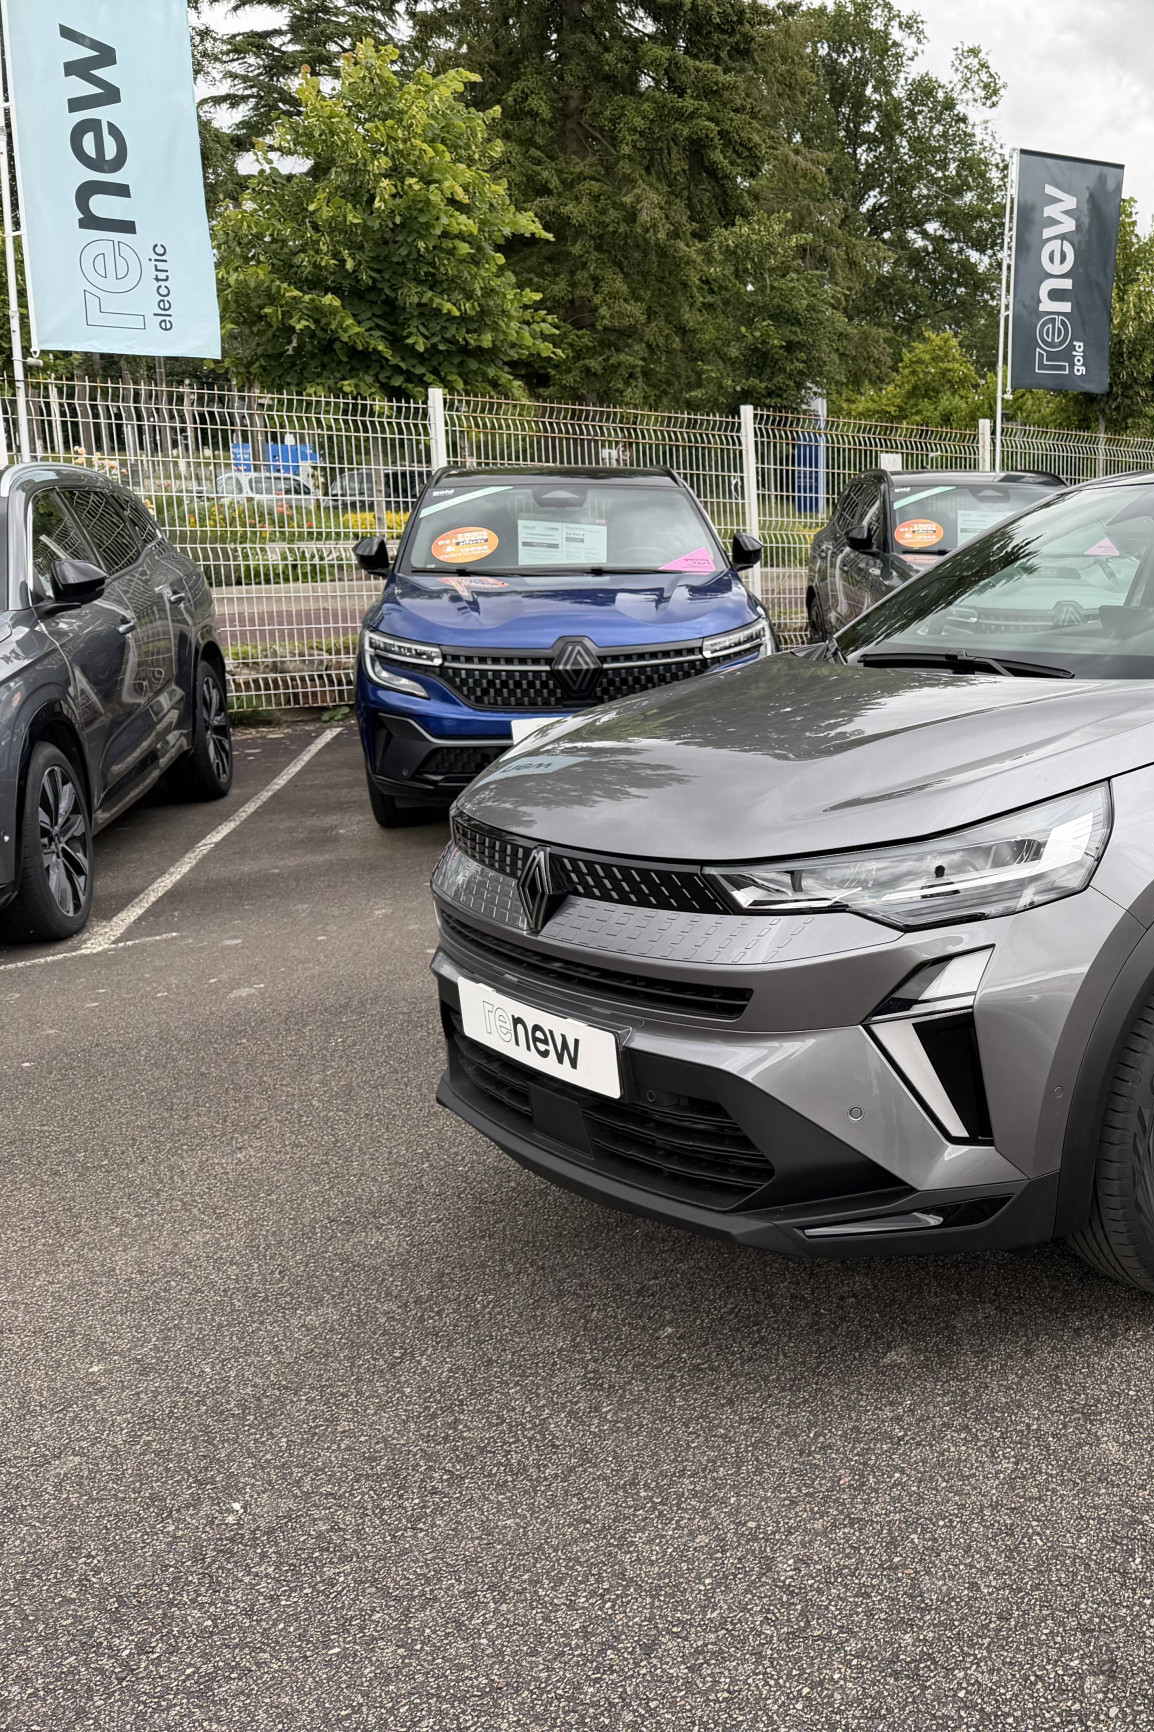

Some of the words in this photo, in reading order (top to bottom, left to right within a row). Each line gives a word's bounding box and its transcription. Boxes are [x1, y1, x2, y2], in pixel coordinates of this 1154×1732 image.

[58, 22, 146, 330] renew
[148, 242, 173, 332] electric
[1034, 183, 1078, 375] renew
[1072, 341, 1086, 376] gold
[482, 999, 580, 1070] renew
